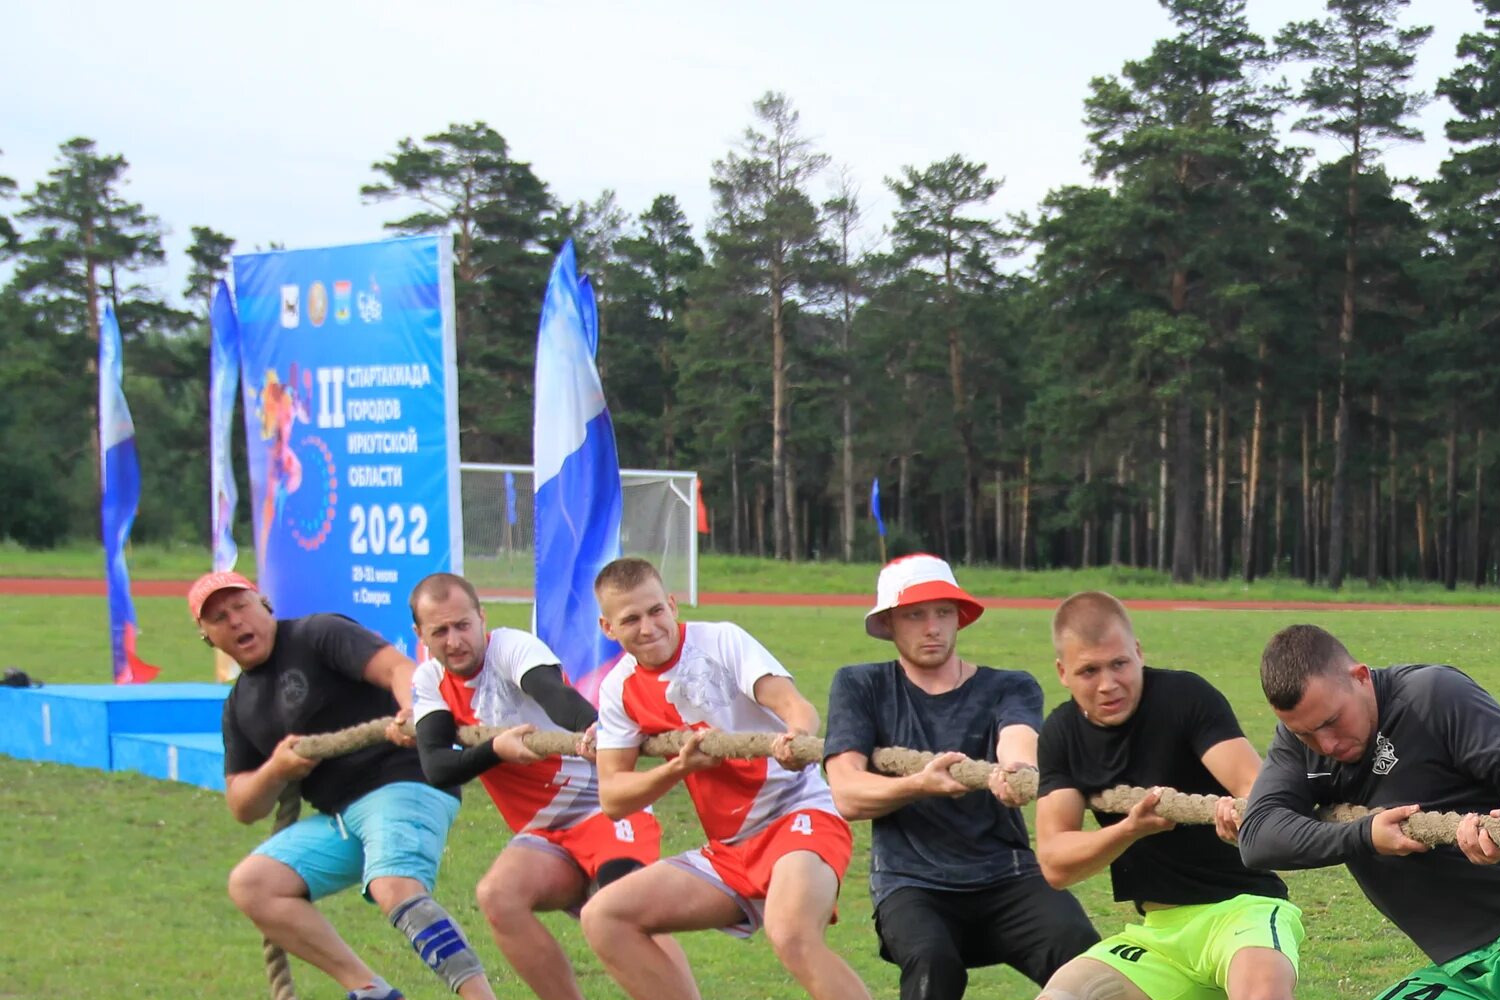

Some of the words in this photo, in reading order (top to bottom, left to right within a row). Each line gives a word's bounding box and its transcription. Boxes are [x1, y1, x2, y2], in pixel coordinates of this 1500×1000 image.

[348, 364, 430, 388] СПАРТАКИАДА
[318, 368, 345, 428] II
[348, 400, 401, 423] ГОРОДОВ
[348, 427, 417, 454] ИРКУТСКОЙ
[349, 466, 402, 487] ОБЛАСТИ
[351, 505, 429, 555] 2022
[791, 814, 813, 835] 4
